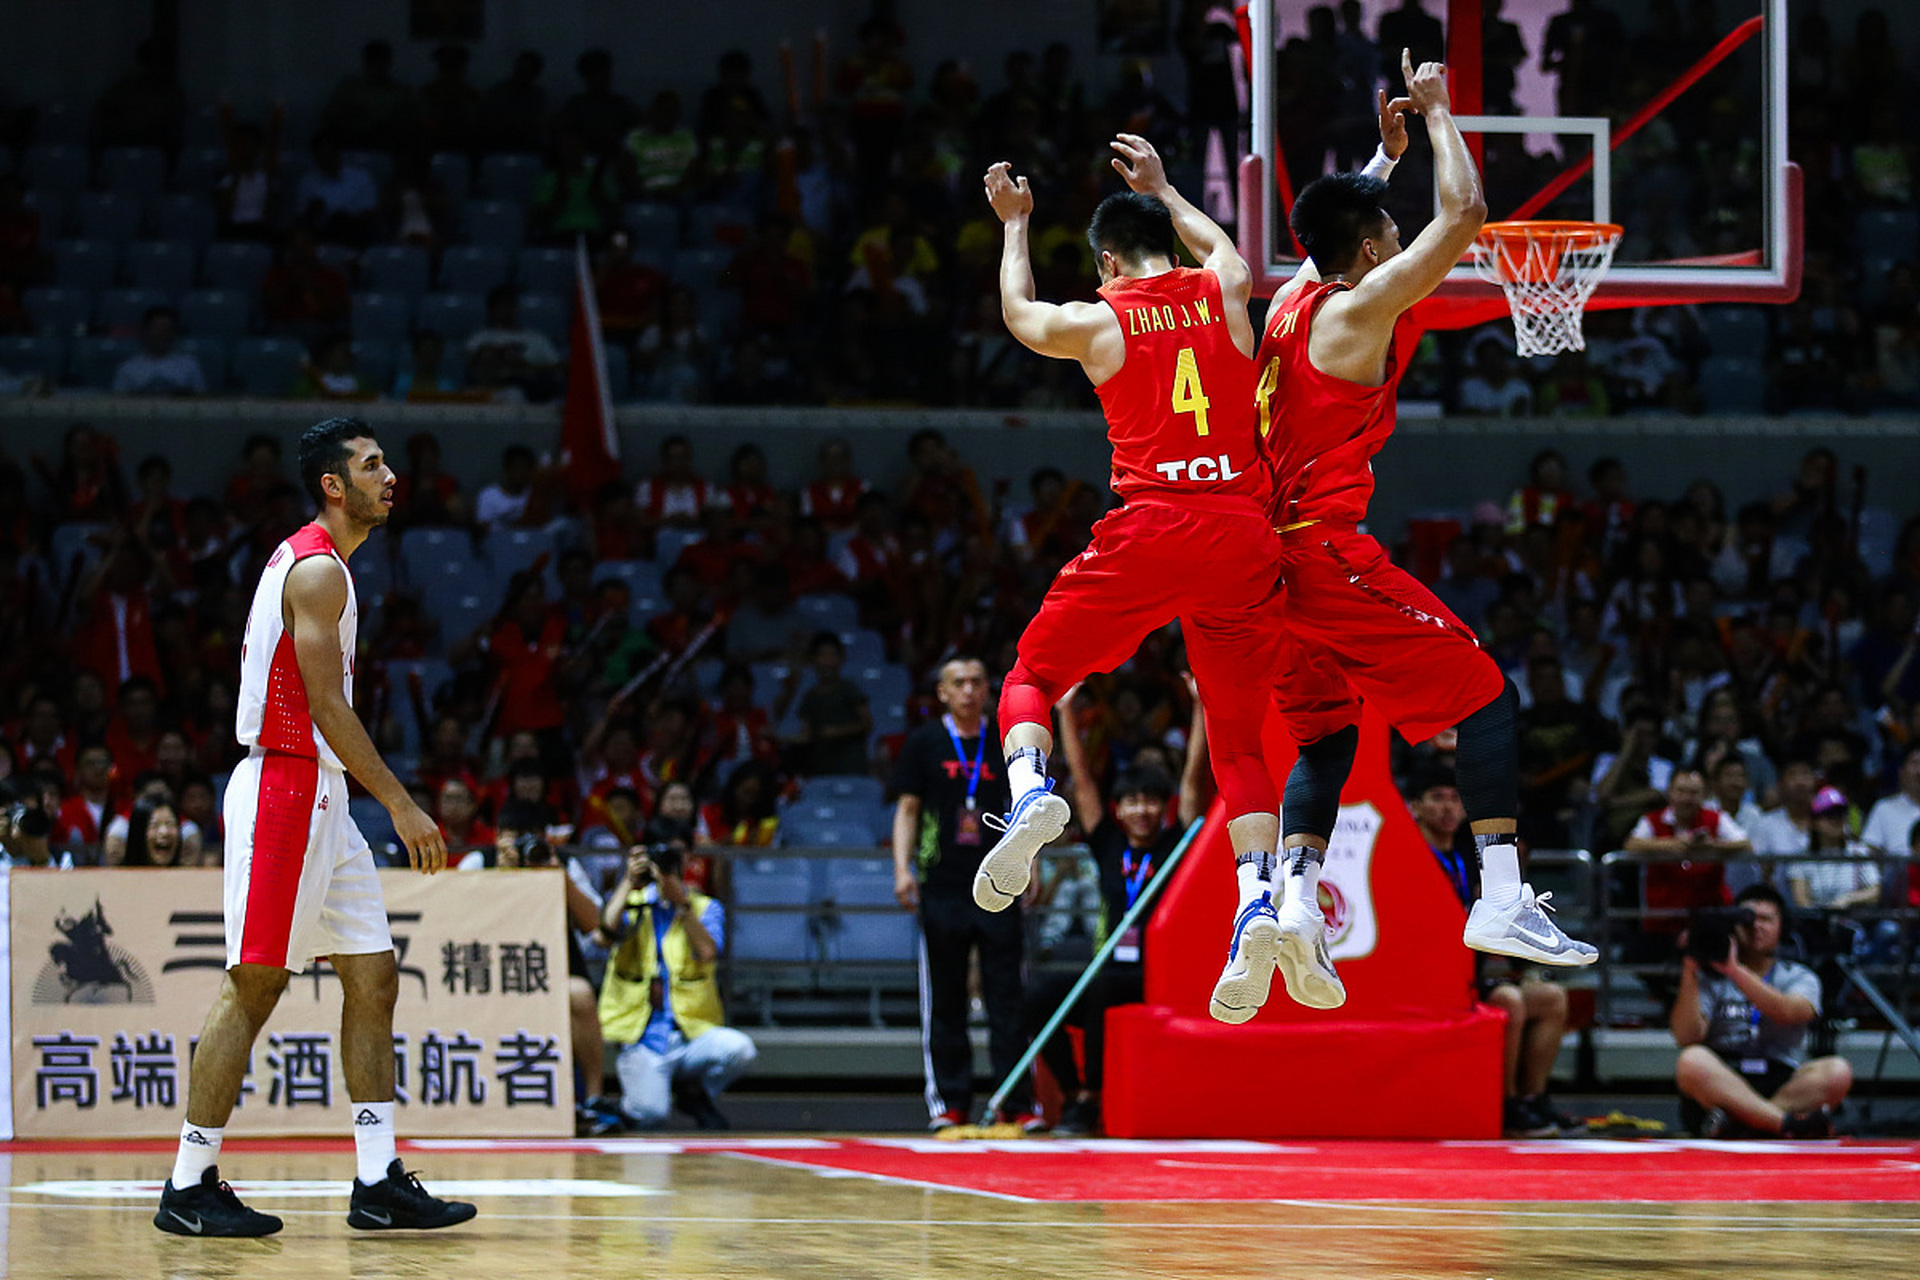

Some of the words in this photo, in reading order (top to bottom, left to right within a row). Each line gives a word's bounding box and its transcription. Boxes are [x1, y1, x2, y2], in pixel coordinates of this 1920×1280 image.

[1125, 304, 1176, 336] ZHAO
[1180, 297, 1221, 329] J.W.
[1171, 346, 1211, 437] 4
[1155, 453, 1243, 482] TCL
[441, 939, 549, 994] 精酿
[32, 1029, 561, 1109] 高端酒航者
